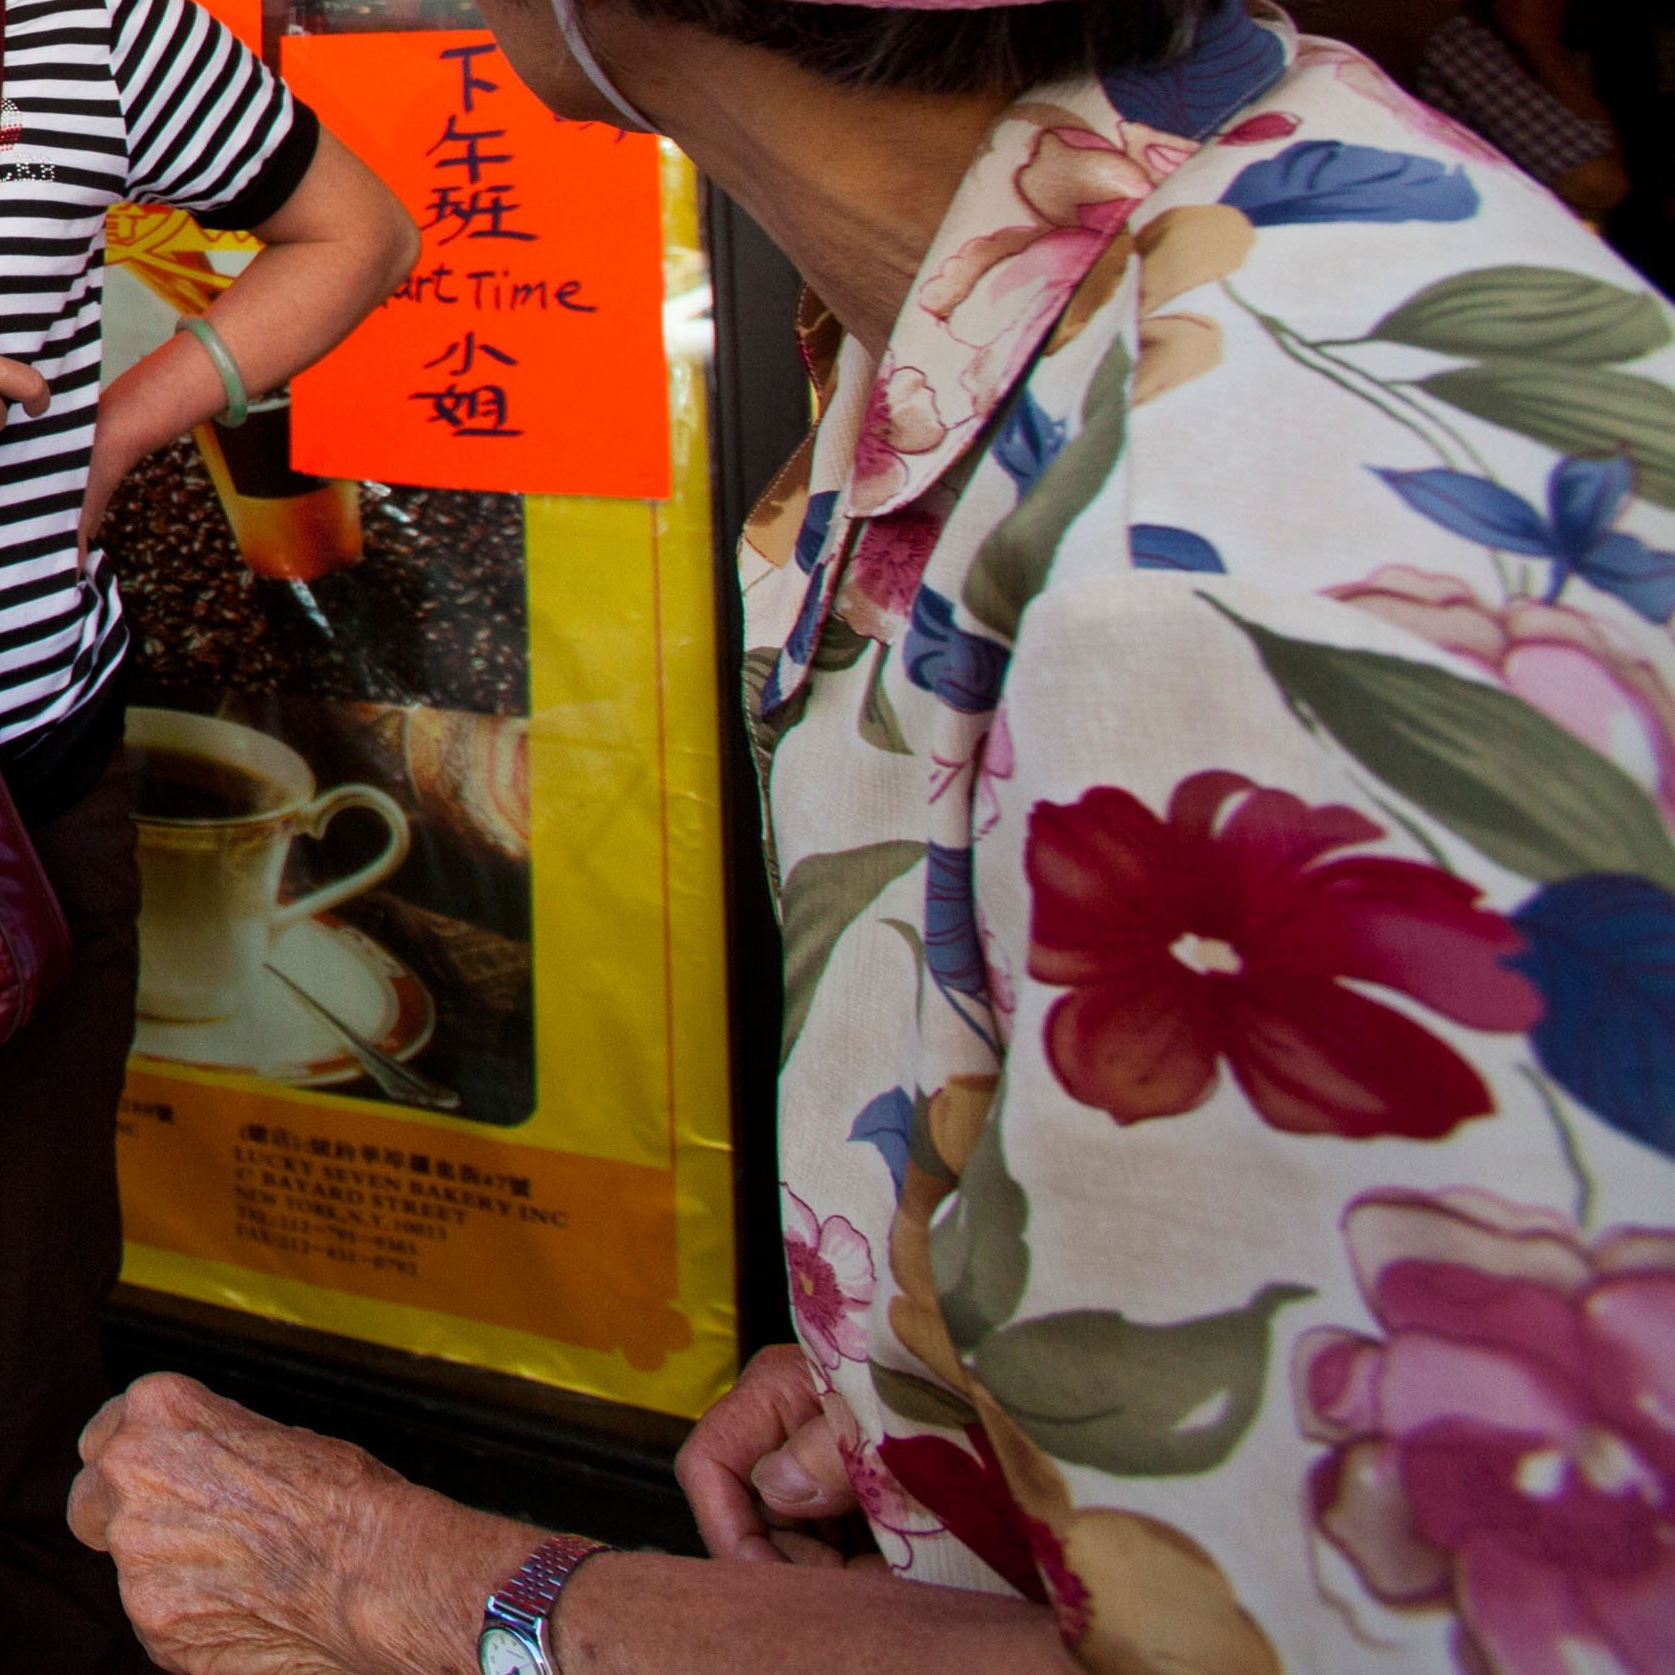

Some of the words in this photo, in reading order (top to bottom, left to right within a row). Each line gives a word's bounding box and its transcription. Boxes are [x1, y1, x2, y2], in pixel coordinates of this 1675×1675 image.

[421, 43, 539, 247] 下午班
[381, 263, 458, 309] art
[466, 269, 599, 313] Time
[409, 330, 526, 438] 小姐
[262, 1172, 365, 1206] BAYARD
[371, 1194, 469, 1225] STREET
[321, 1165, 401, 1192] SEVEN
[409, 1180, 512, 1217] BAKERY
[520, 1205, 568, 1227] INC
